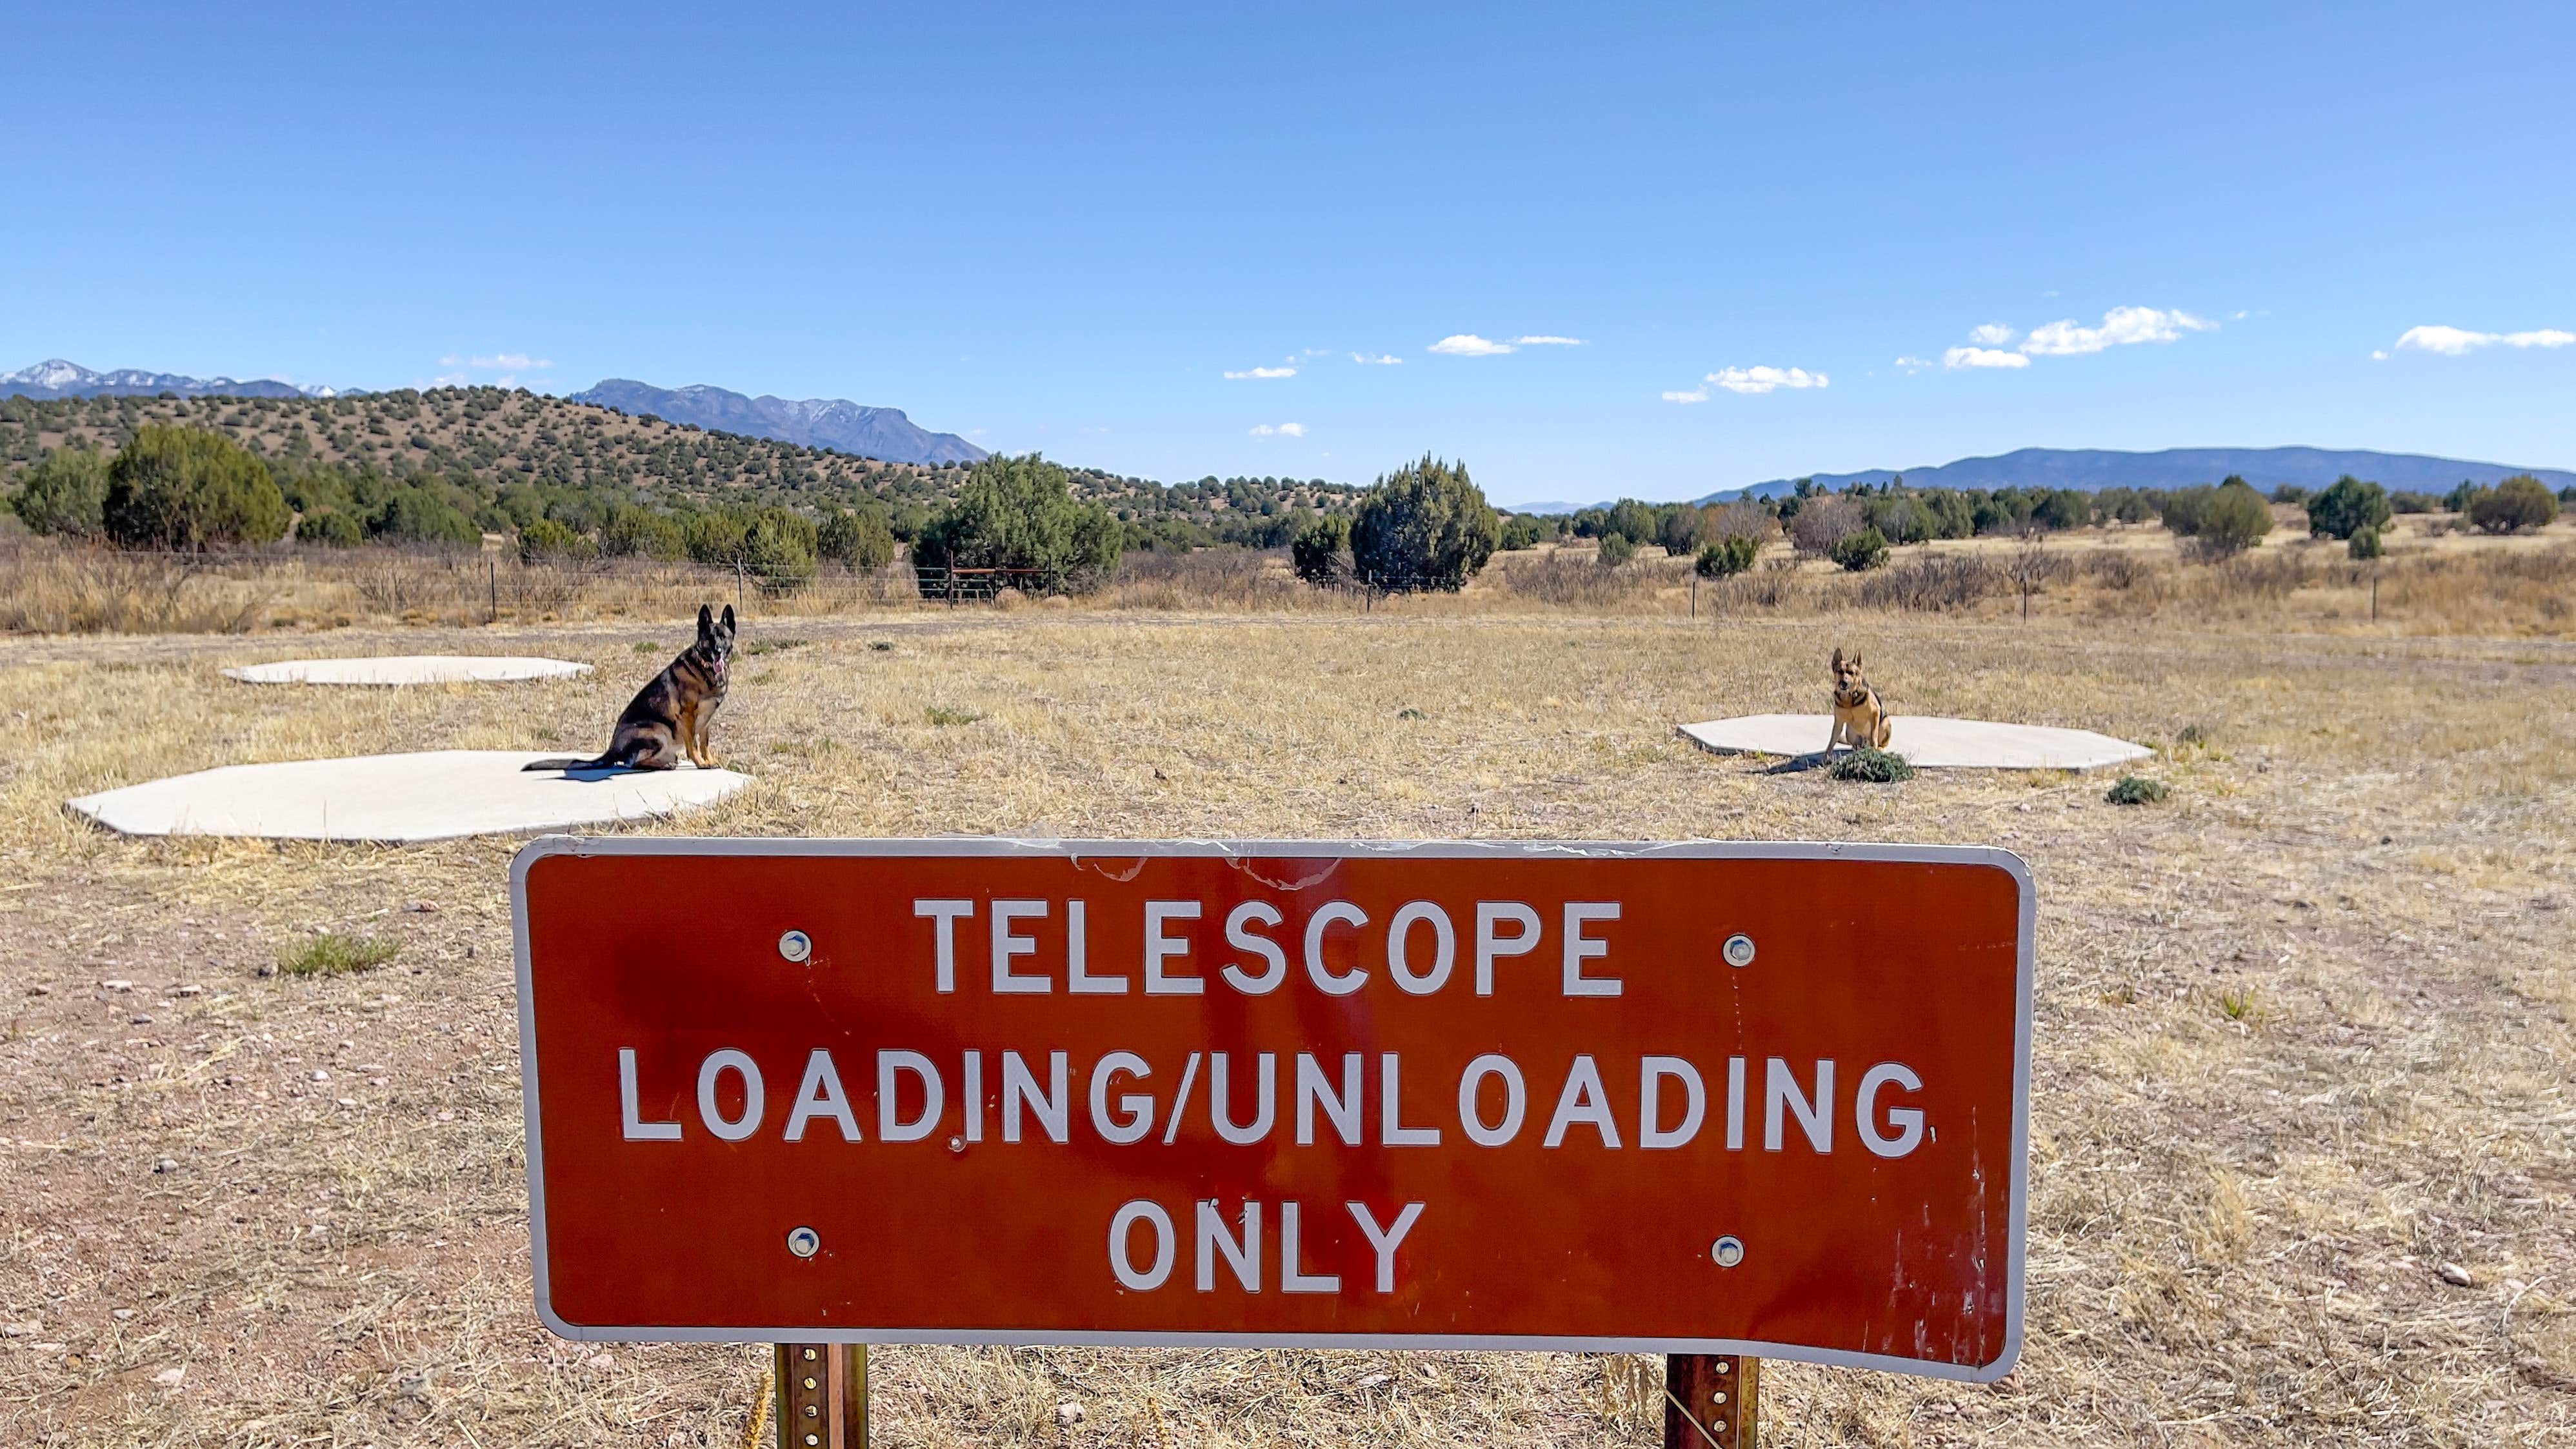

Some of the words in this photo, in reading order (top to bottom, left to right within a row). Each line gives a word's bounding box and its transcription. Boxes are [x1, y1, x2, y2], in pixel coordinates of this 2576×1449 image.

[913, 899, 1624, 996] TELESCOPE
[618, 1048, 1926, 1159] LOADING/UNLOADING
[1108, 1198, 1426, 1294] ONLY
